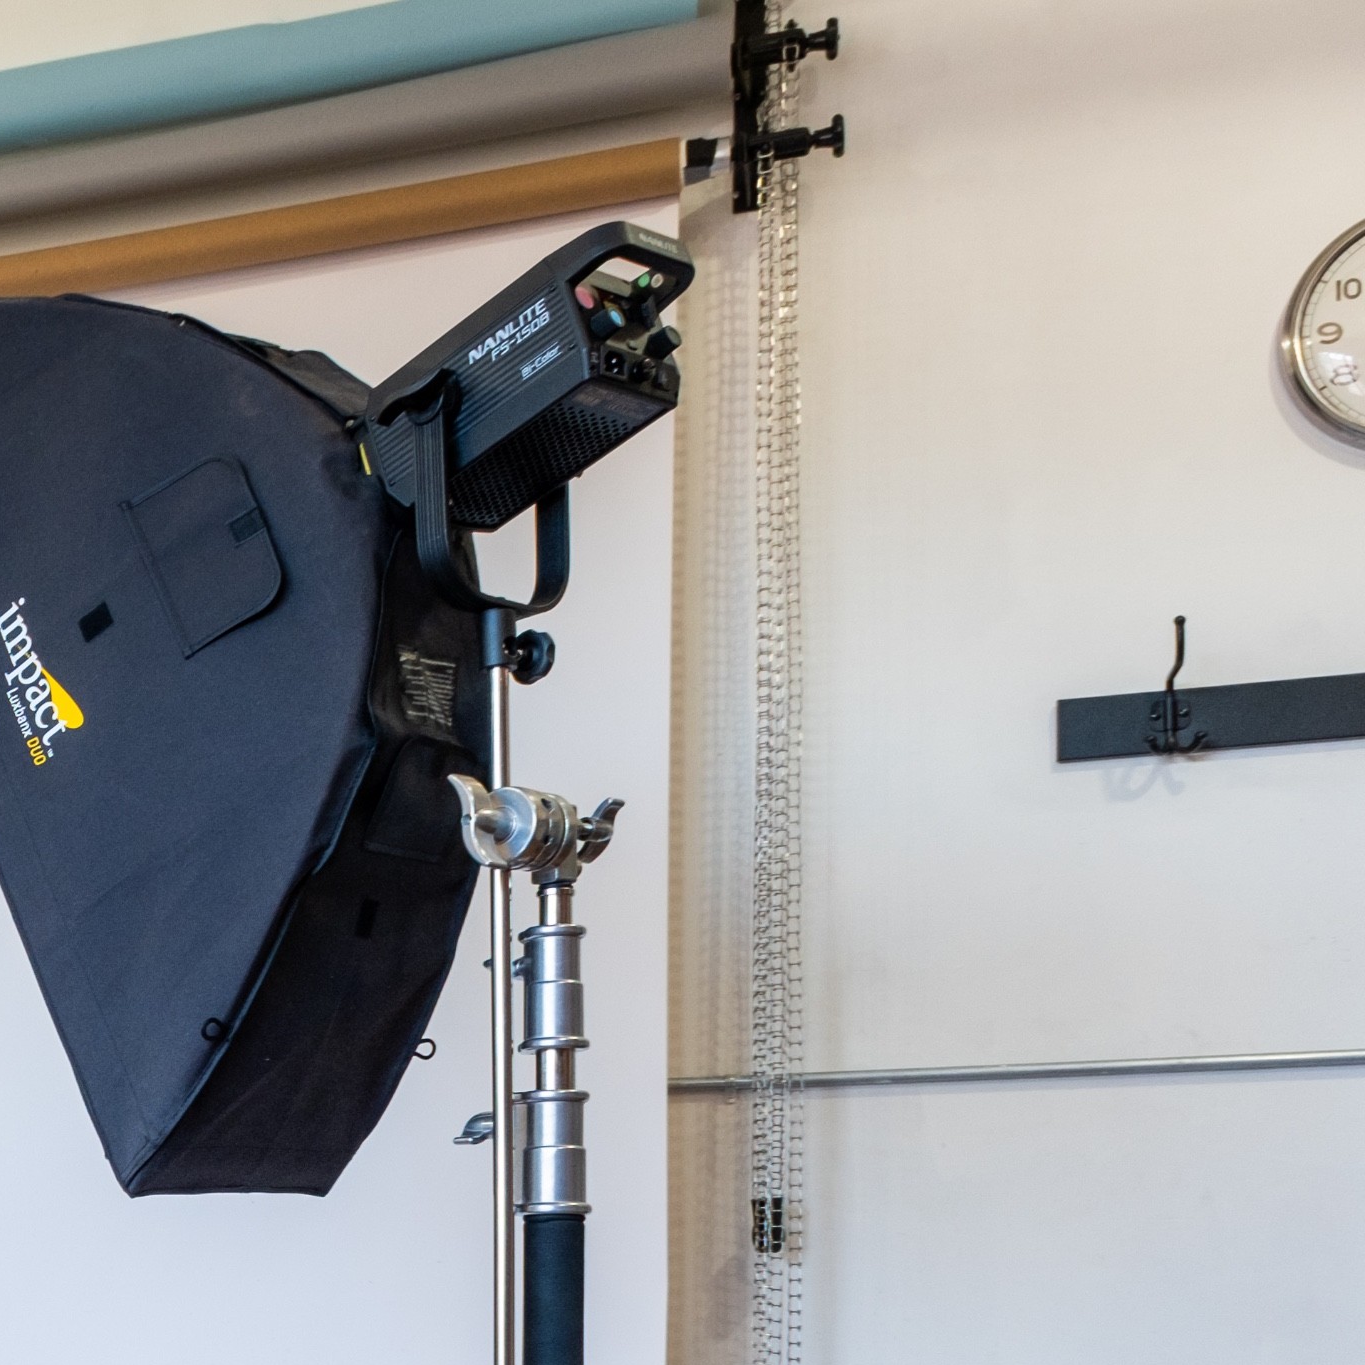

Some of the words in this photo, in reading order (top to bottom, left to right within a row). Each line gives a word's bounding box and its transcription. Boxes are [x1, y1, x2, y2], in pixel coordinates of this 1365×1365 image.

[1335, 278, 1362, 302] 10
[468, 298, 547, 365] NANLITE
[491, 311, 550, 362] FS-150B
[1317, 322, 1343, 345] 9
[1330, 364, 1357, 386] 8
[6, 687, 33, 739] Luxbanx
[26, 736, 47, 766] DUO
